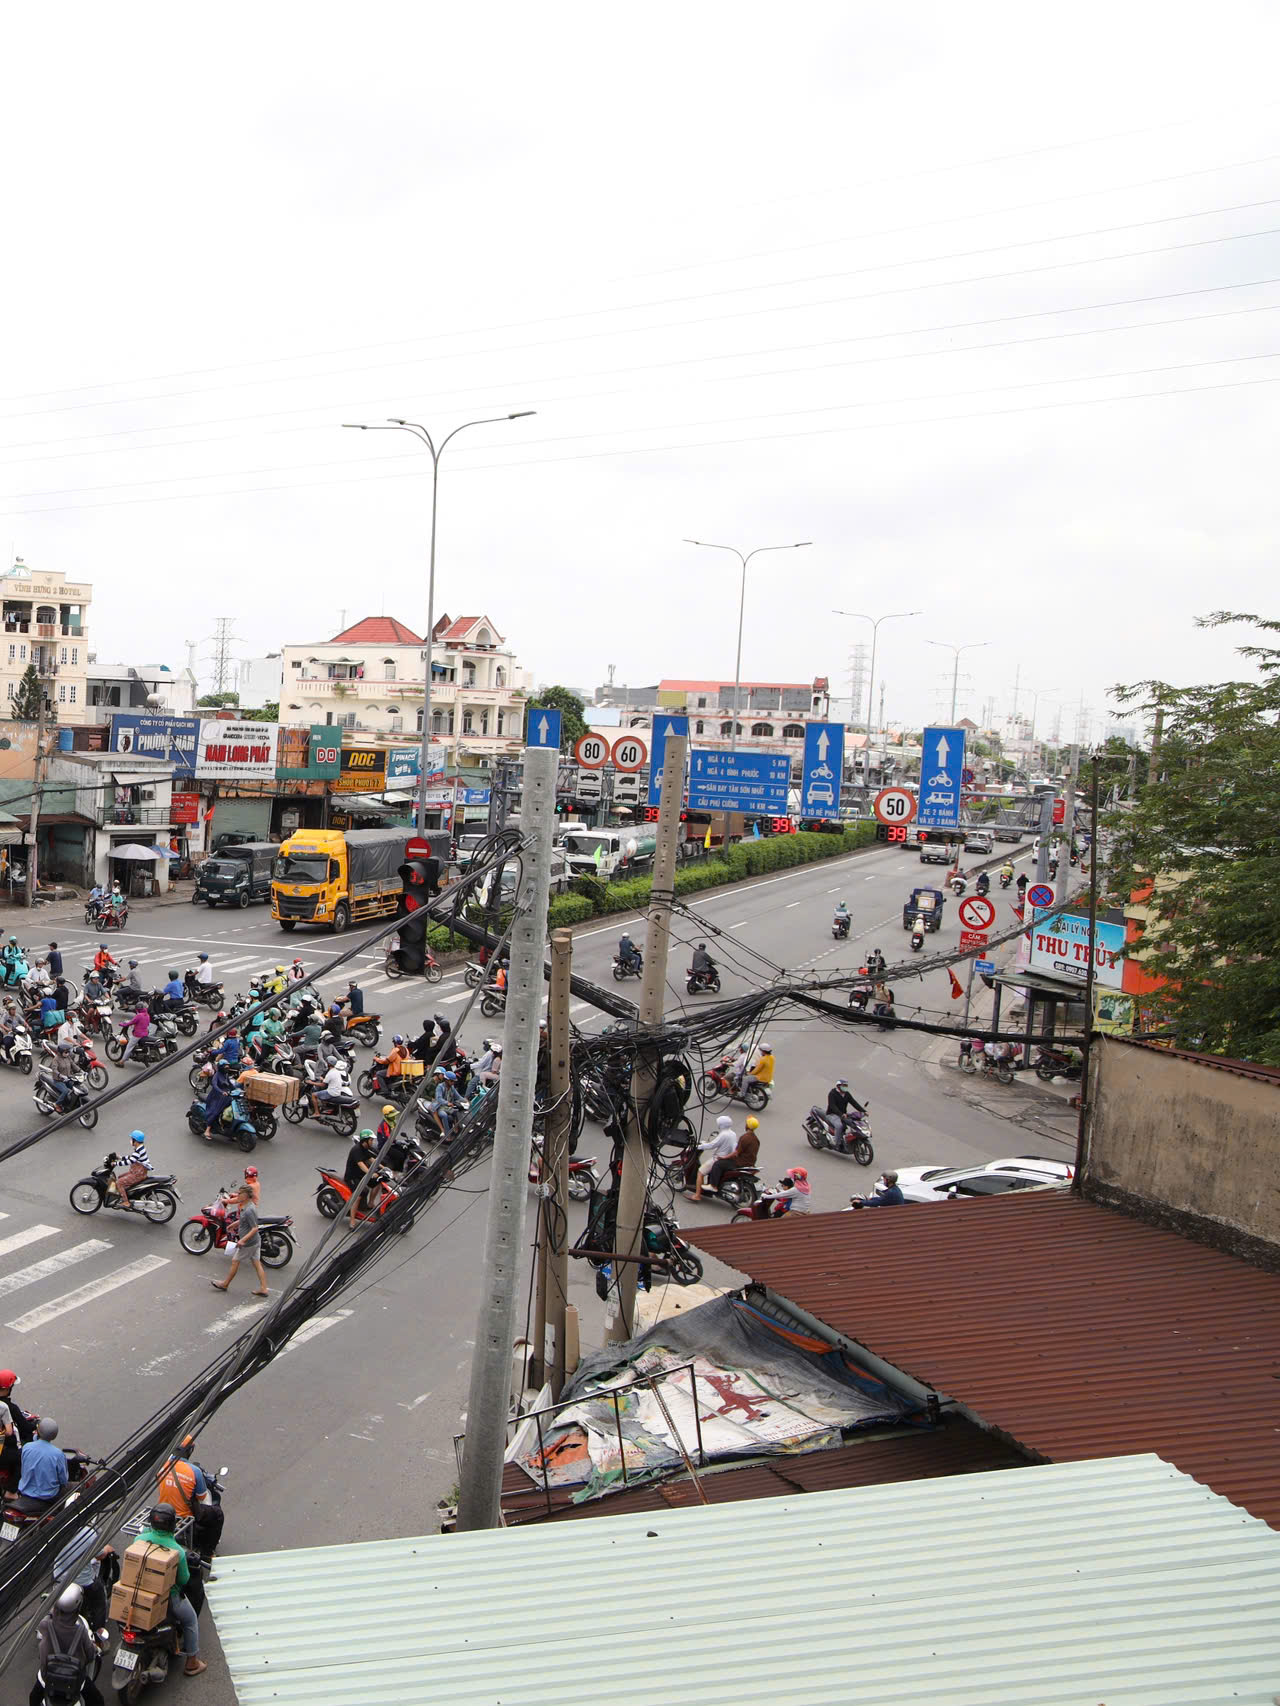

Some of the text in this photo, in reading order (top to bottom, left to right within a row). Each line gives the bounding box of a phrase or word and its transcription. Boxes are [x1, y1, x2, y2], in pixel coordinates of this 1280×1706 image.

[205, 742, 271, 763] NAM LONG PHÁT
[585, 743, 600, 759] 80
[621, 746, 637, 763] 60
[777, 772, 787, 780] KM
[718, 785, 727, 793] BAY
[776, 789, 786, 797] KM
[644, 807, 660, 822] 39
[887, 799, 905, 817] 50
[923, 808, 931, 816] XE
[939, 808, 954, 817] BÁNH
[772, 818, 789, 834] 39
[888, 826, 906, 842] 39
[1071, 922, 1081, 935] LÝ
[1036, 934, 1070, 957] THU
